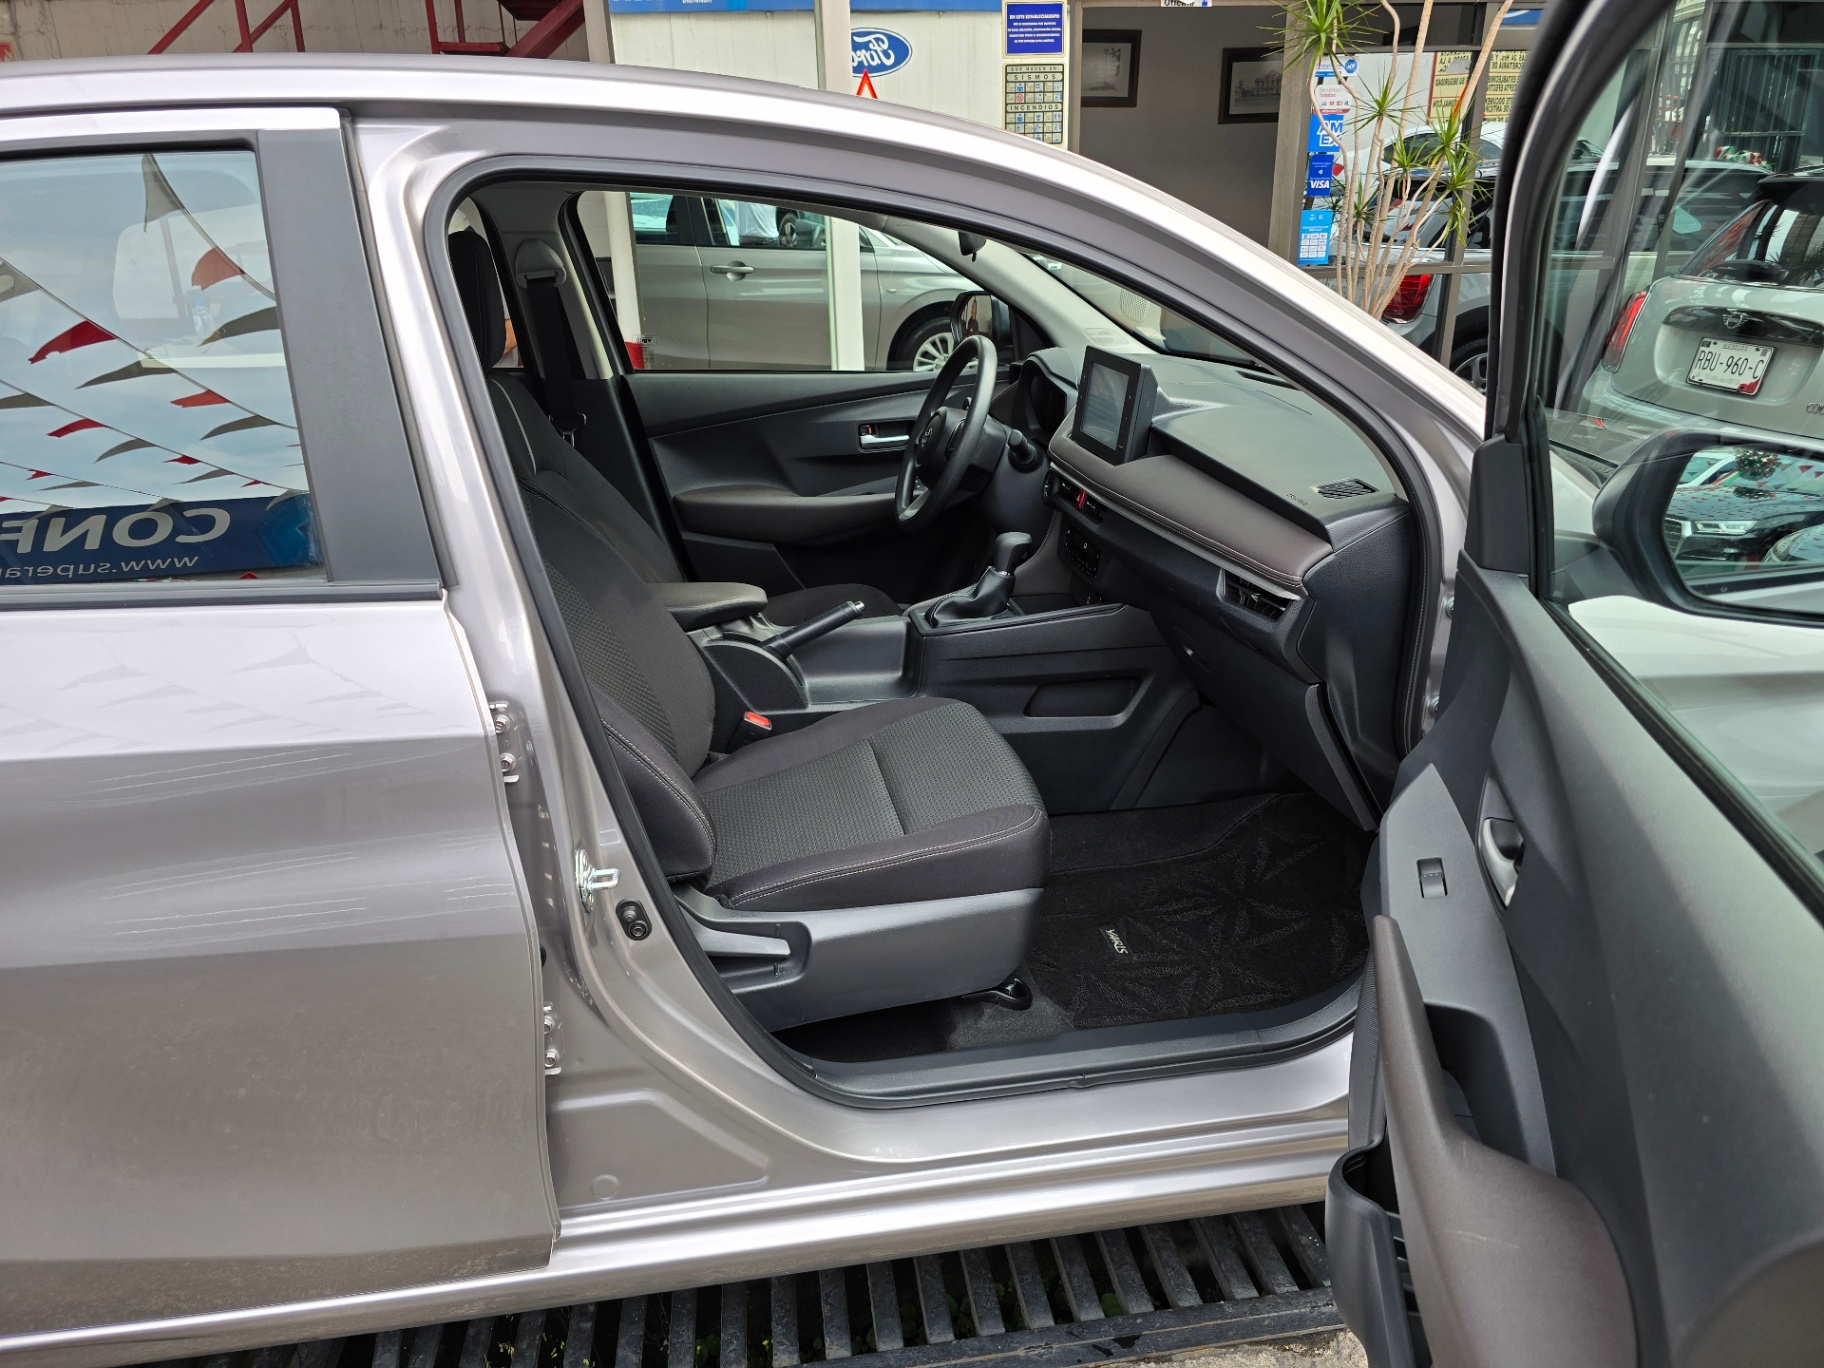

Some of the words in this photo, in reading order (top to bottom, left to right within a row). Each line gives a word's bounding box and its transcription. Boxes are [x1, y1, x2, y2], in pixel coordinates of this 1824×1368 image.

[1316, 120, 1344, 135] AM
[1309, 180, 1330, 188] VISA
[1695, 350, 1765, 379] RBU-960-C
[1105, 929, 1128, 954] YARIS
